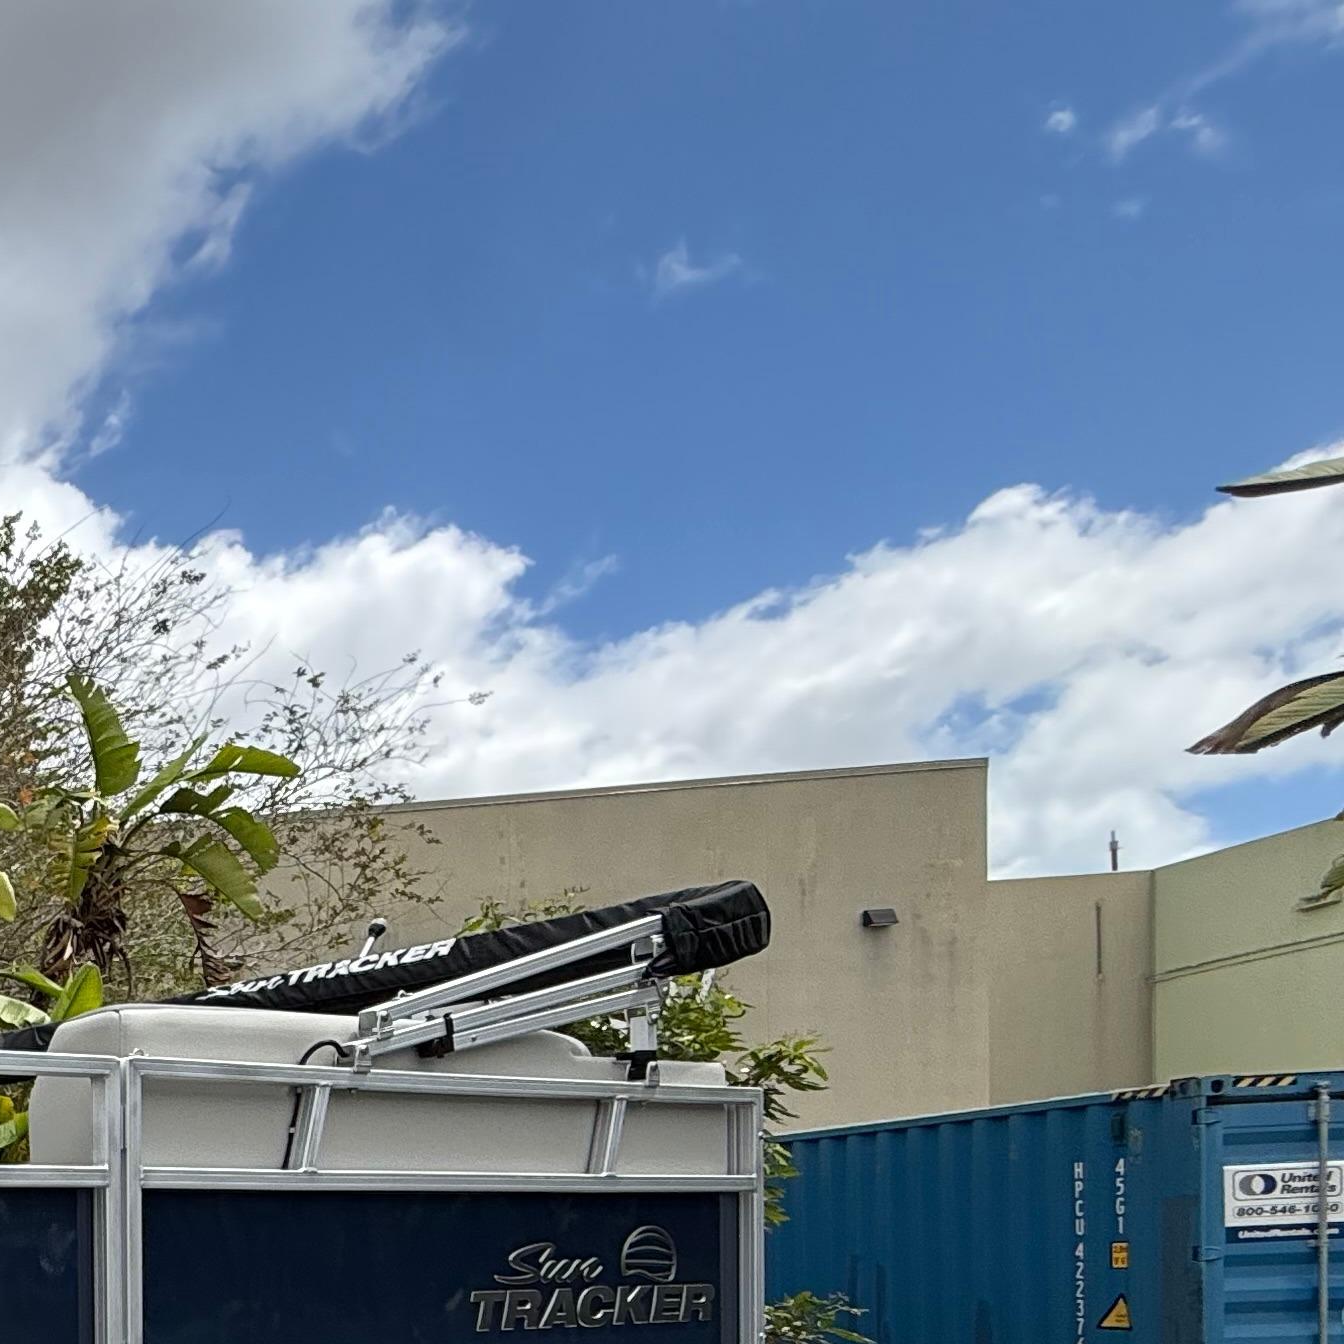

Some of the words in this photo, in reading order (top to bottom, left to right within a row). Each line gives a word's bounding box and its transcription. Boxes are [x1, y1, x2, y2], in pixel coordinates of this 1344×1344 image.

[287, 938, 456, 987] TRACKER
[1074, 1162, 1084, 1235] HPCU
[1115, 1158, 1125, 1234] 45G1
[1236, 1204, 1339, 1217] 800-546-100
[1280, 1184, 1336, 1194] Rentas
[494, 1242, 604, 1285] Sun
[470, 1283, 715, 1332] TRACKER
